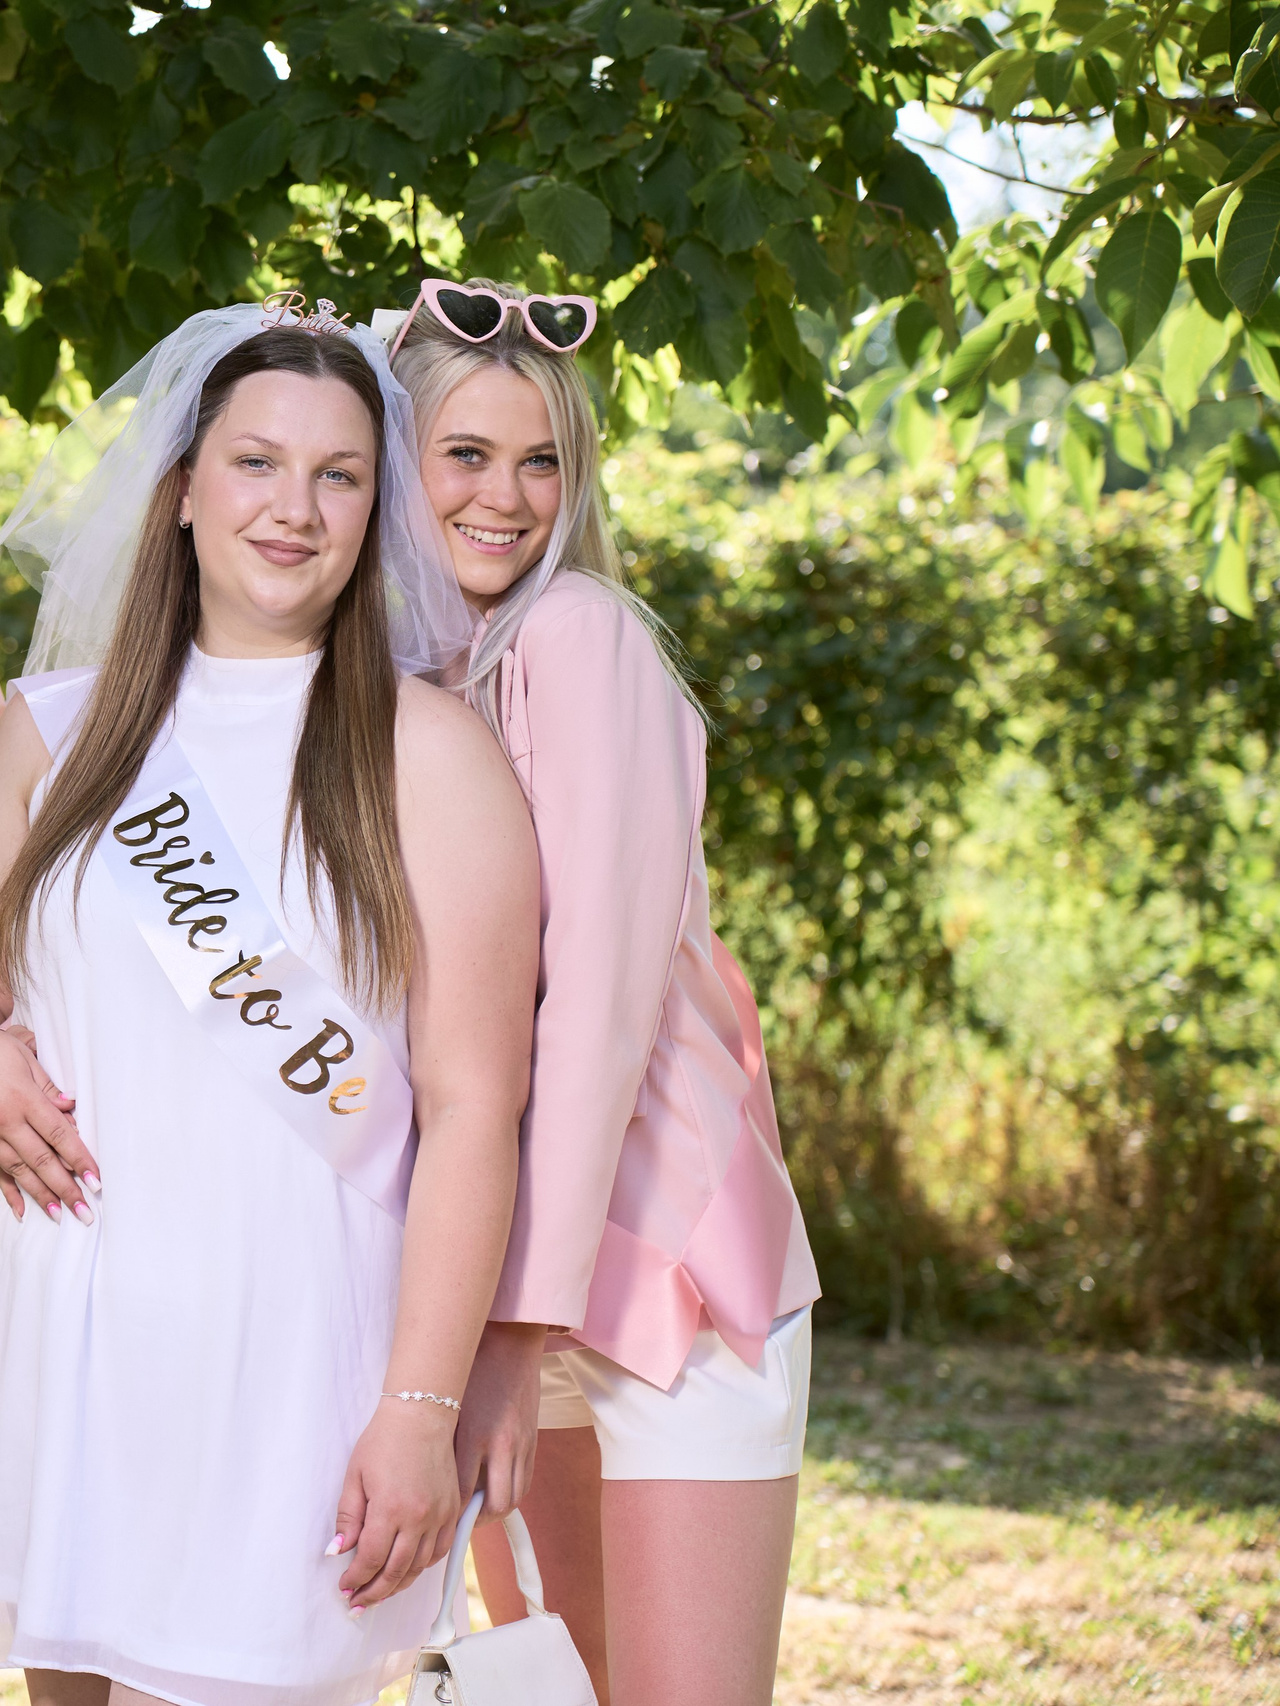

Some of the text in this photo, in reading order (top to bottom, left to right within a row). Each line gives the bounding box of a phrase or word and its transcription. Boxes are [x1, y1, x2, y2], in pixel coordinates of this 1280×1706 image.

[260, 289, 352, 336] Bride
[112, 791, 369, 1116] Bride to Be
